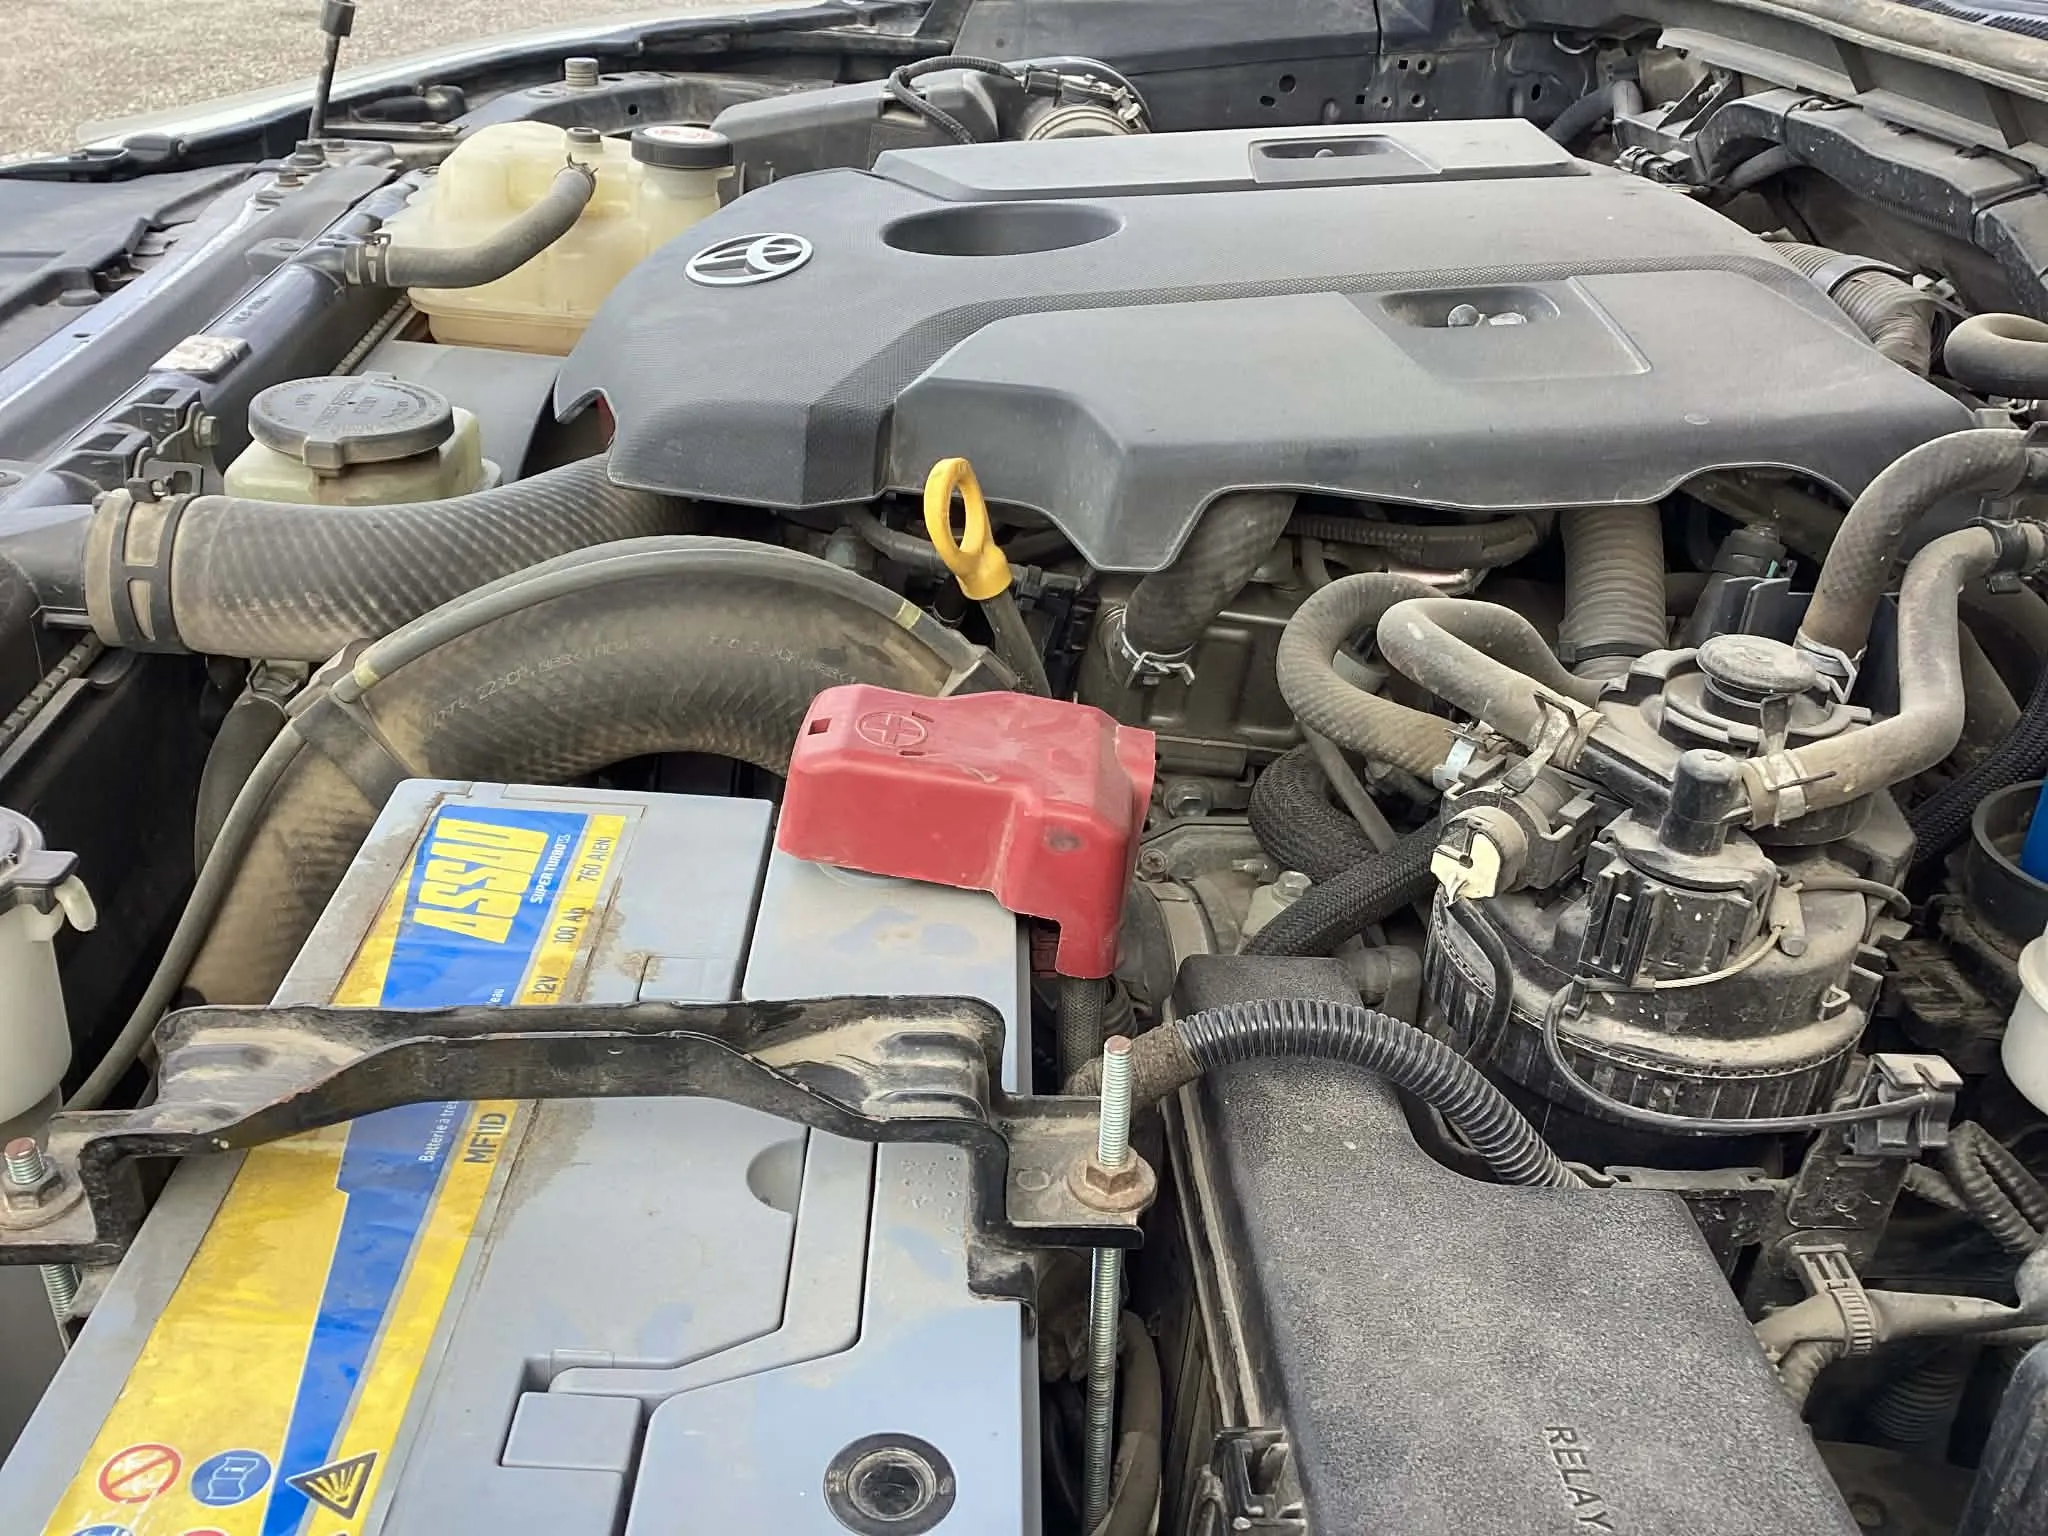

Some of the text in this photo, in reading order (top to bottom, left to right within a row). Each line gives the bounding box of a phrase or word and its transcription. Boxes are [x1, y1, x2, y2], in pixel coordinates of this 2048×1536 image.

[413, 818, 549, 943] ASSAD
[529, 871, 554, 904] SUPER
[532, 975, 560, 993] 12V
[553, 925, 579, 943] 100
[576, 863, 602, 882] 760
[418, 1124, 448, 1162] Batterie
[1545, 1426, 1615, 1531] RELAY
